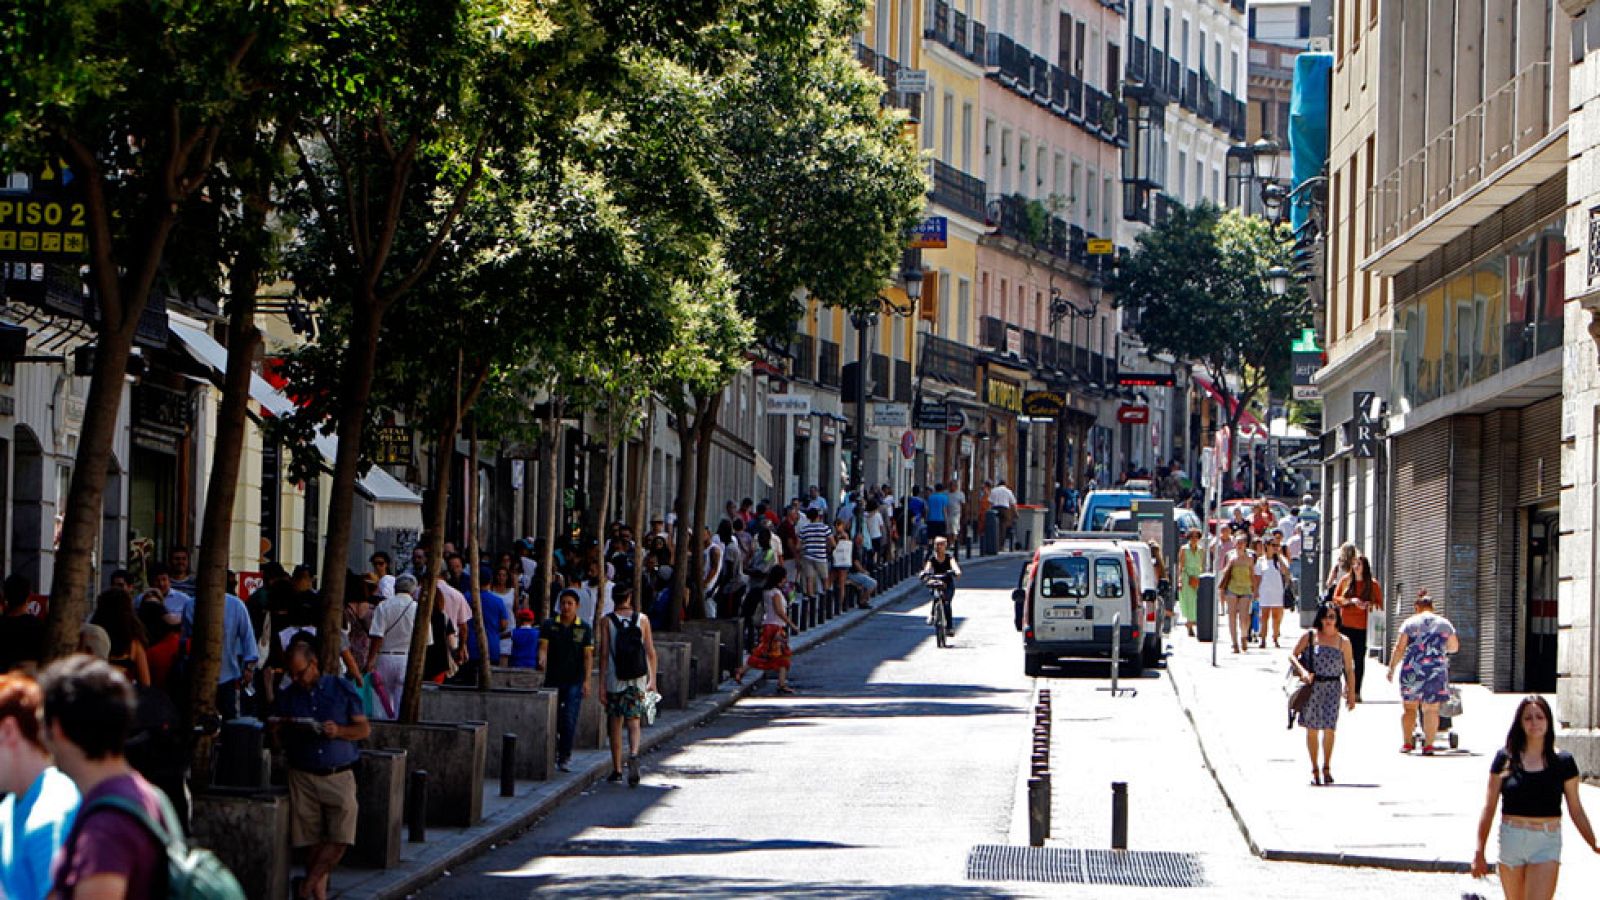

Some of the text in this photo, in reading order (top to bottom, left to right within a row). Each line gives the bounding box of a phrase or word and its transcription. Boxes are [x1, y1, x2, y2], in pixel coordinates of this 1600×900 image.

[0, 200, 86, 227] PISO 2
[1358, 392, 1372, 457] ZARA
